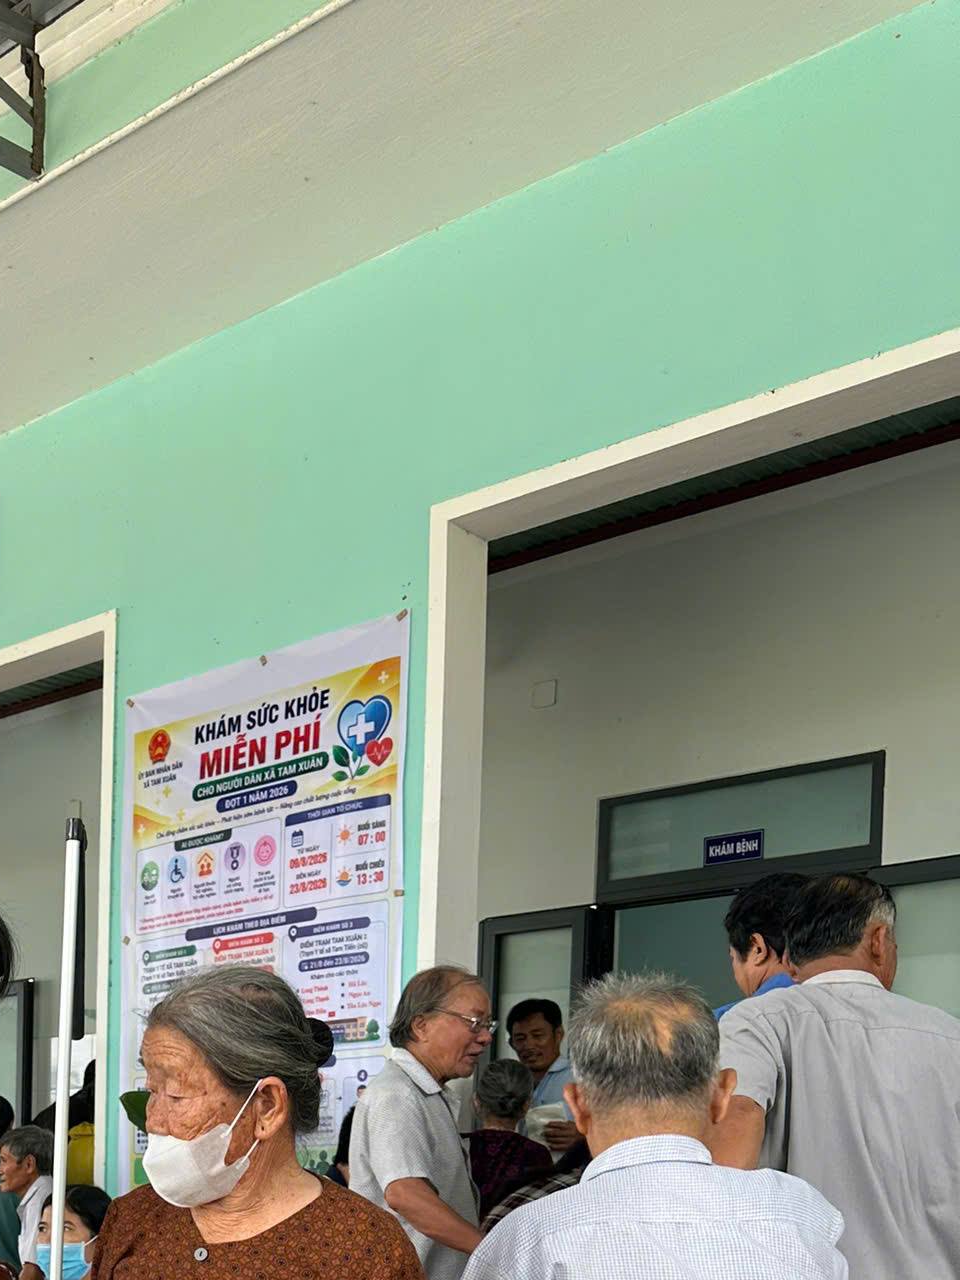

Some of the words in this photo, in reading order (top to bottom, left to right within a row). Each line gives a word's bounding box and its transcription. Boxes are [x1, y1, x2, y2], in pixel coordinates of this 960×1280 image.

[194, 714, 241, 745] KHÁM
[246, 702, 280, 730] SỨC
[284, 686, 330, 719] KHỎE
[199, 733, 267, 780] MIỄN
[274, 713, 321, 760] PHÍ
[197, 785, 215, 798] CHO
[216, 778, 243, 794] NGƯỜI
[244, 773, 262, 788] DÂN
[264, 768, 276, 780] XÃ
[277, 764, 296, 778] TAM
[297, 755, 323, 773] XUÂN
[224, 797, 241, 809] ĐỢT
[243, 796, 247, 804] 1
[248, 790, 268, 803] NĂM
[269, 784, 289, 798] 2026
[357, 833, 368, 846] 07
[375, 831, 386, 843] 00
[709, 841, 735, 858] KHÁM
[735, 838, 759, 857] BỆNH
[356, 873, 368, 886] 13
[373, 871, 384, 883] 30
